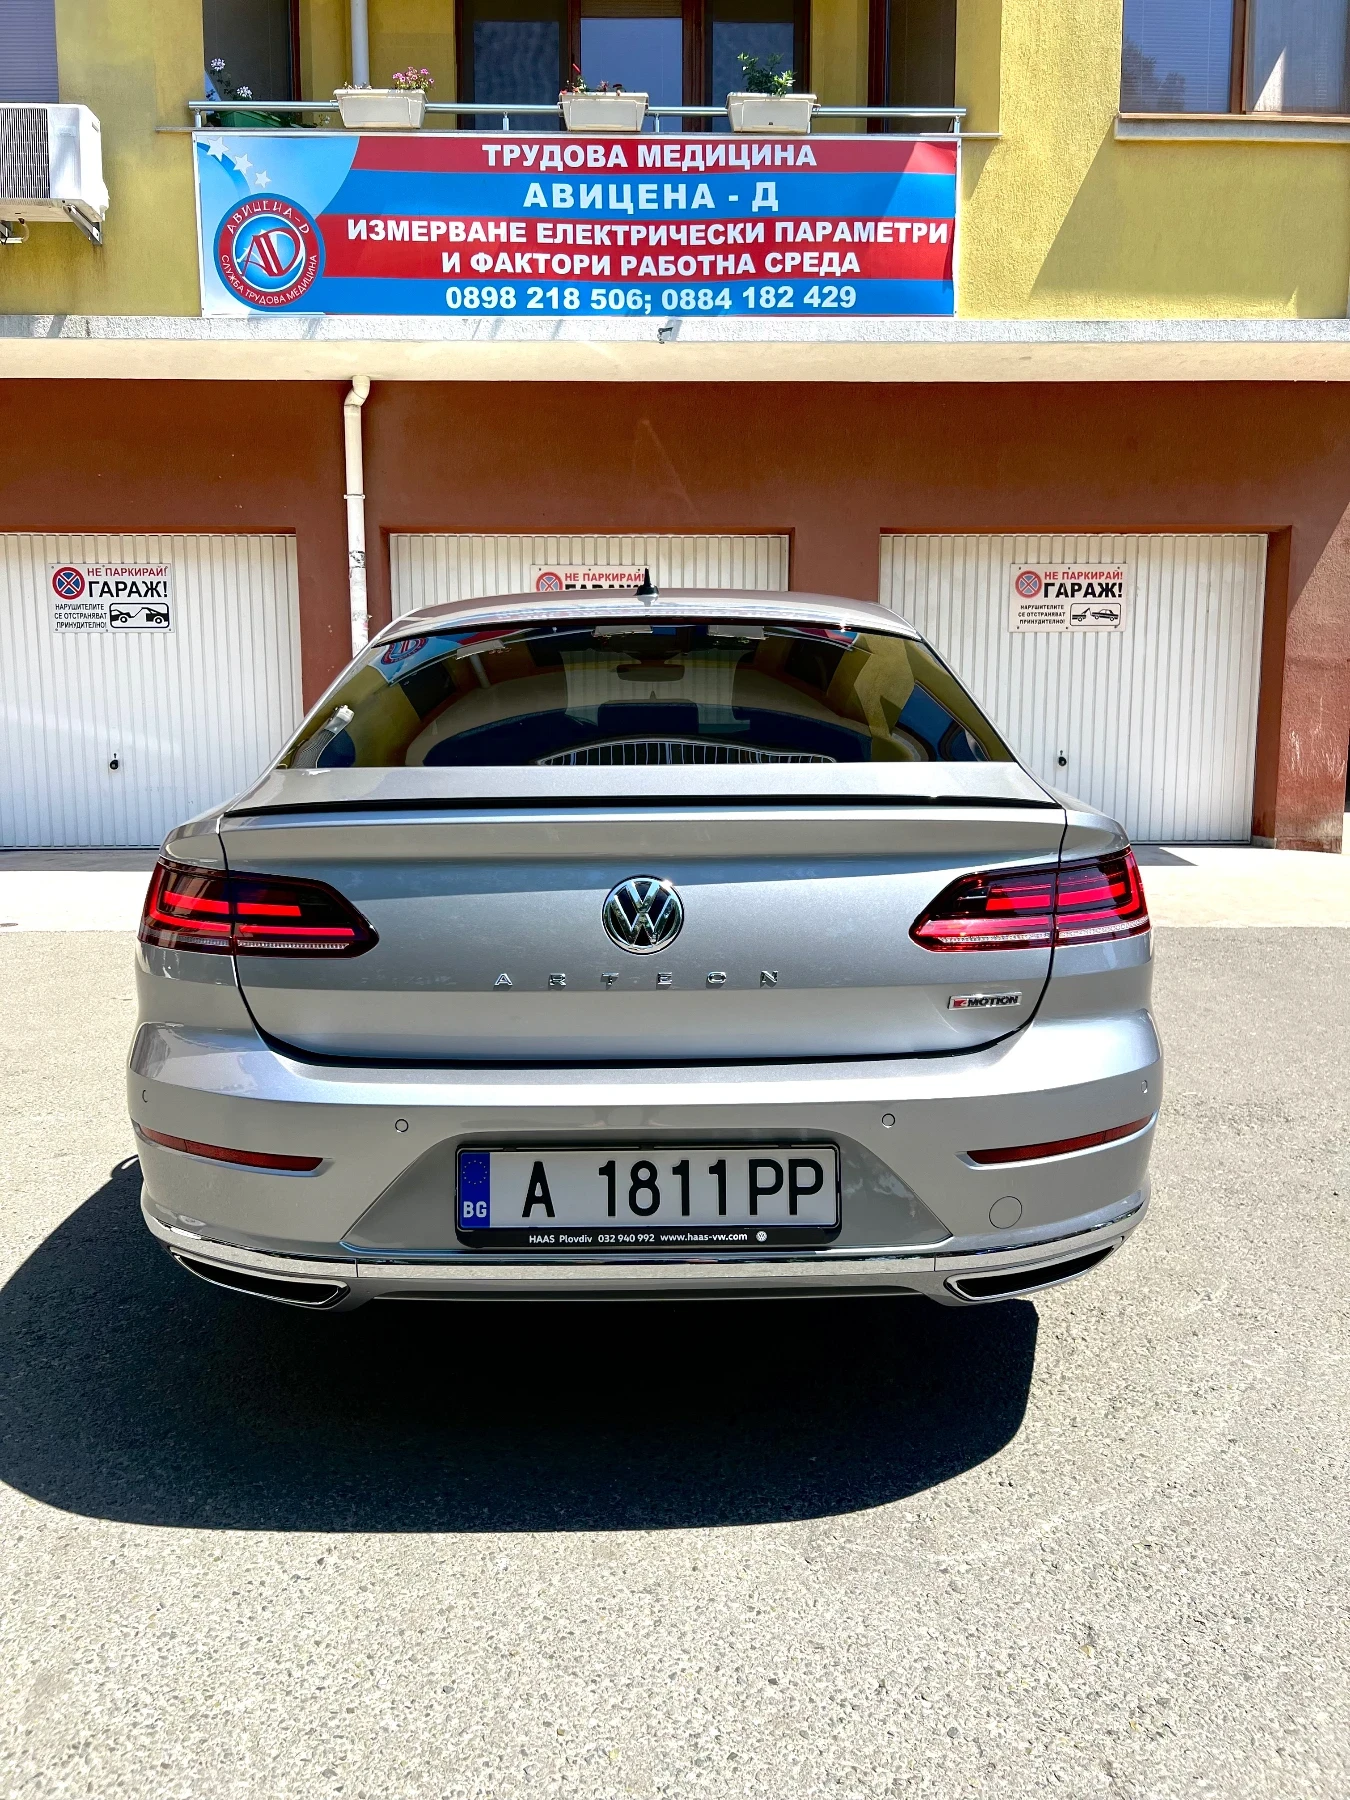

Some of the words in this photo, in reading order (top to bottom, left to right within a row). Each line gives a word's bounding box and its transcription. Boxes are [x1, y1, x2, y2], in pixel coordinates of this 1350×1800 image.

[482, 144, 628, 171] ТРУДОВА
[637, 144, 816, 172] МЕДИЦИНА
[522, 182, 715, 215] АВИЦЕНА
[751, 181, 779, 212] Д
[347, 219, 527, 243] ИЗМЕРВАНЕ
[537, 222, 764, 246] ЕЛЕКТРИЧЕСКИ
[775, 222, 948, 244] ПАРАМЕТРИ
[441, 252, 461, 273] И
[470, 252, 611, 276] ФАКТОРИ
[621, 253, 756, 277] РАБОТНА
[764, 251, 861, 277] СРЕДА
[221, 254, 243, 293] СЛУЖБА
[245, 289, 287, 305] ТРУДОВА
[286, 254, 317, 301] МЕДИЦИНА
[445, 286, 517, 309] 0898
[526, 286, 580, 310] 218
[590, 288, 652, 315] 506;
[661, 288, 732, 310] 0884
[742, 285, 794, 309] 182
[803, 285, 857, 309] 429
[87, 568, 101, 577] НЕ
[105, 566, 168, 577] ПАРКИРАЙ!
[565, 573, 579, 581] НЕ
[1044, 571, 1058, 580] НЕ
[1062, 569, 1123, 580] ПАРКИРАЙ!
[88, 581, 168, 598] ГАРАЖ!
[1044, 582, 1123, 598] ГАРАЖ!
[55, 603, 104, 611] НАРУШИТЕЛИТЕ
[54, 612, 62, 620] СЕ
[63, 612, 107, 620] ОТСТРАНЯВАТ
[56, 621, 107, 629] ПРИНУДИТЕЛНО!
[494, 970, 779, 986] ARTEON
[521, 1160, 555, 1218] A
[463, 1201, 487, 1218] BG
[529, 1234, 555, 1243] HAAS
[559, 1234, 593, 1243] Plovdiv
[597, 1234, 615, 1243] 032
[618, 1234, 636, 1243] 940
[637, 1233, 655, 1242] 992
[660, 1232, 748, 1242] www.haas-vw.com
